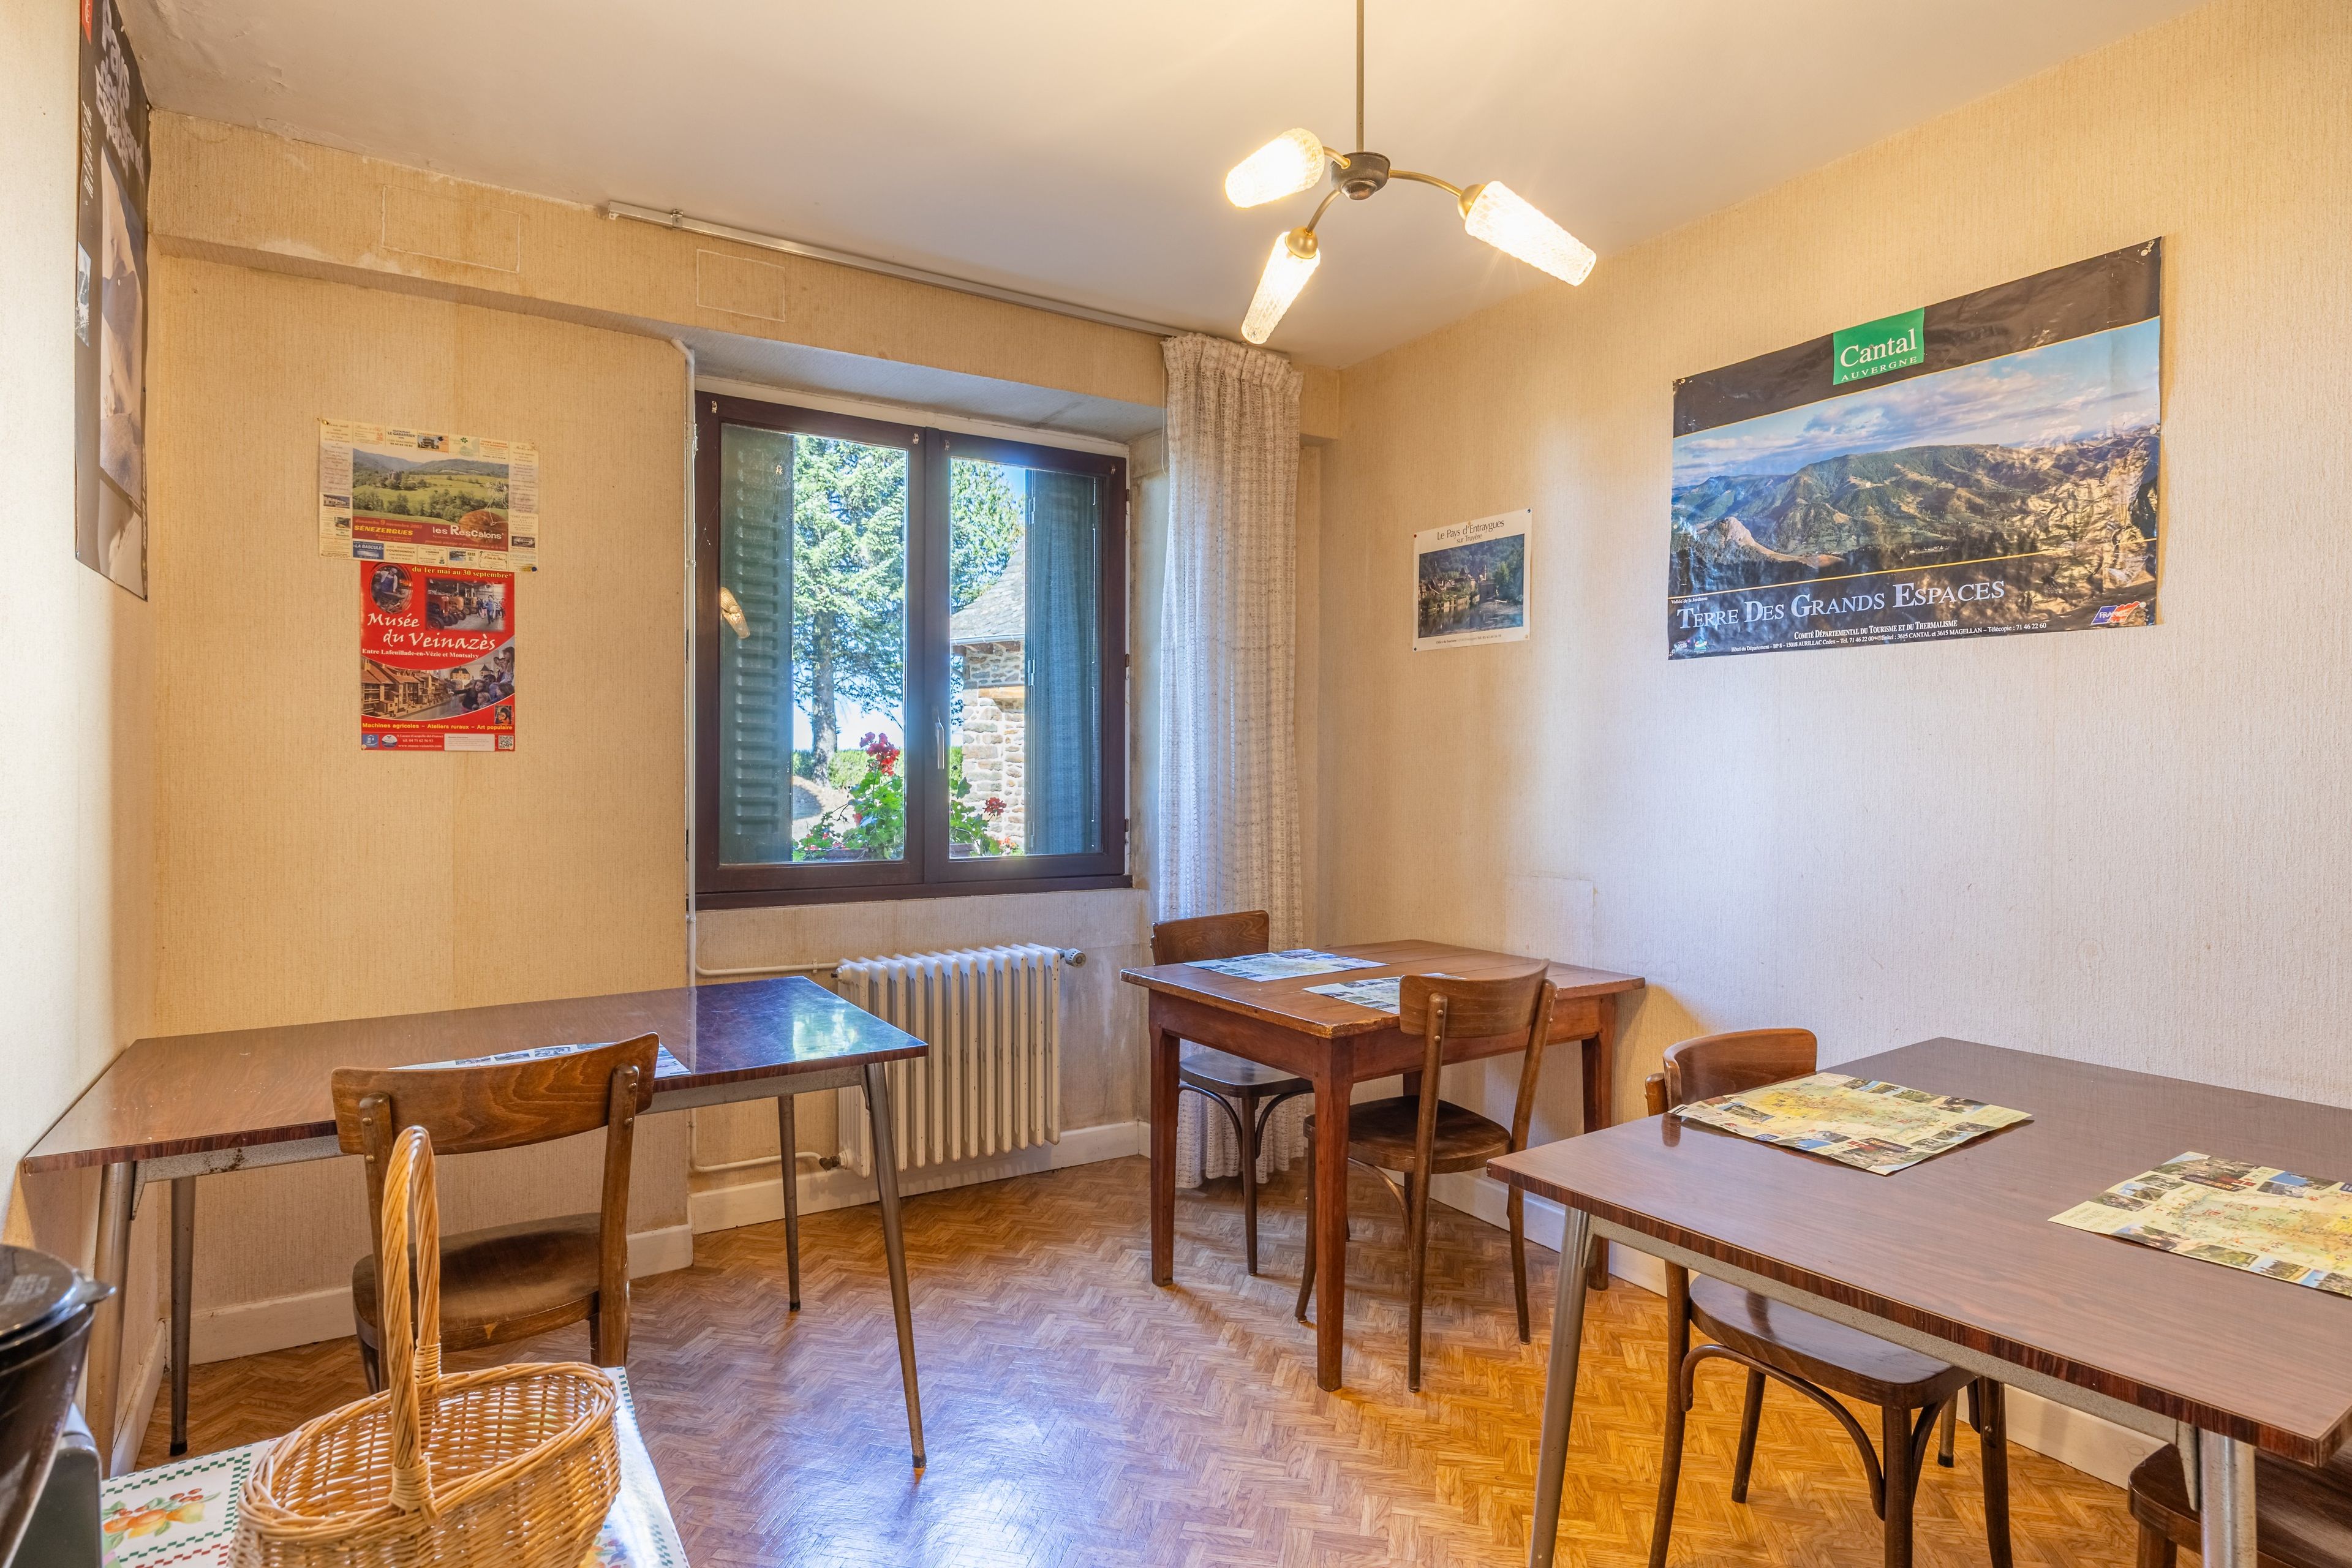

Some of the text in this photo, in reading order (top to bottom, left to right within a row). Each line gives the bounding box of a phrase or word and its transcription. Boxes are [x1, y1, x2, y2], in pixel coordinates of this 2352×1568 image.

[1841, 328, 1917, 367] Cantal
[1841, 356, 1917, 382] AUVERGNE
[354, 525, 413, 535] SÉNEZERGUES
[1447, 529, 1460, 539] Pays
[1463, 520, 1504, 535] d'Entraygues
[1464, 533, 1482, 542] Truyère
[1677, 581, 2005, 629] TERRE DES GRANDS ESPACES
[368, 612, 420, 627] Musée
[1815, 629, 1859, 638] DÉPARTEMENTAL
[1869, 625, 1898, 634] TOURISME
[1915, 620, 1958, 630] THERMALISME
[383, 629, 496, 650] du Veinazès
